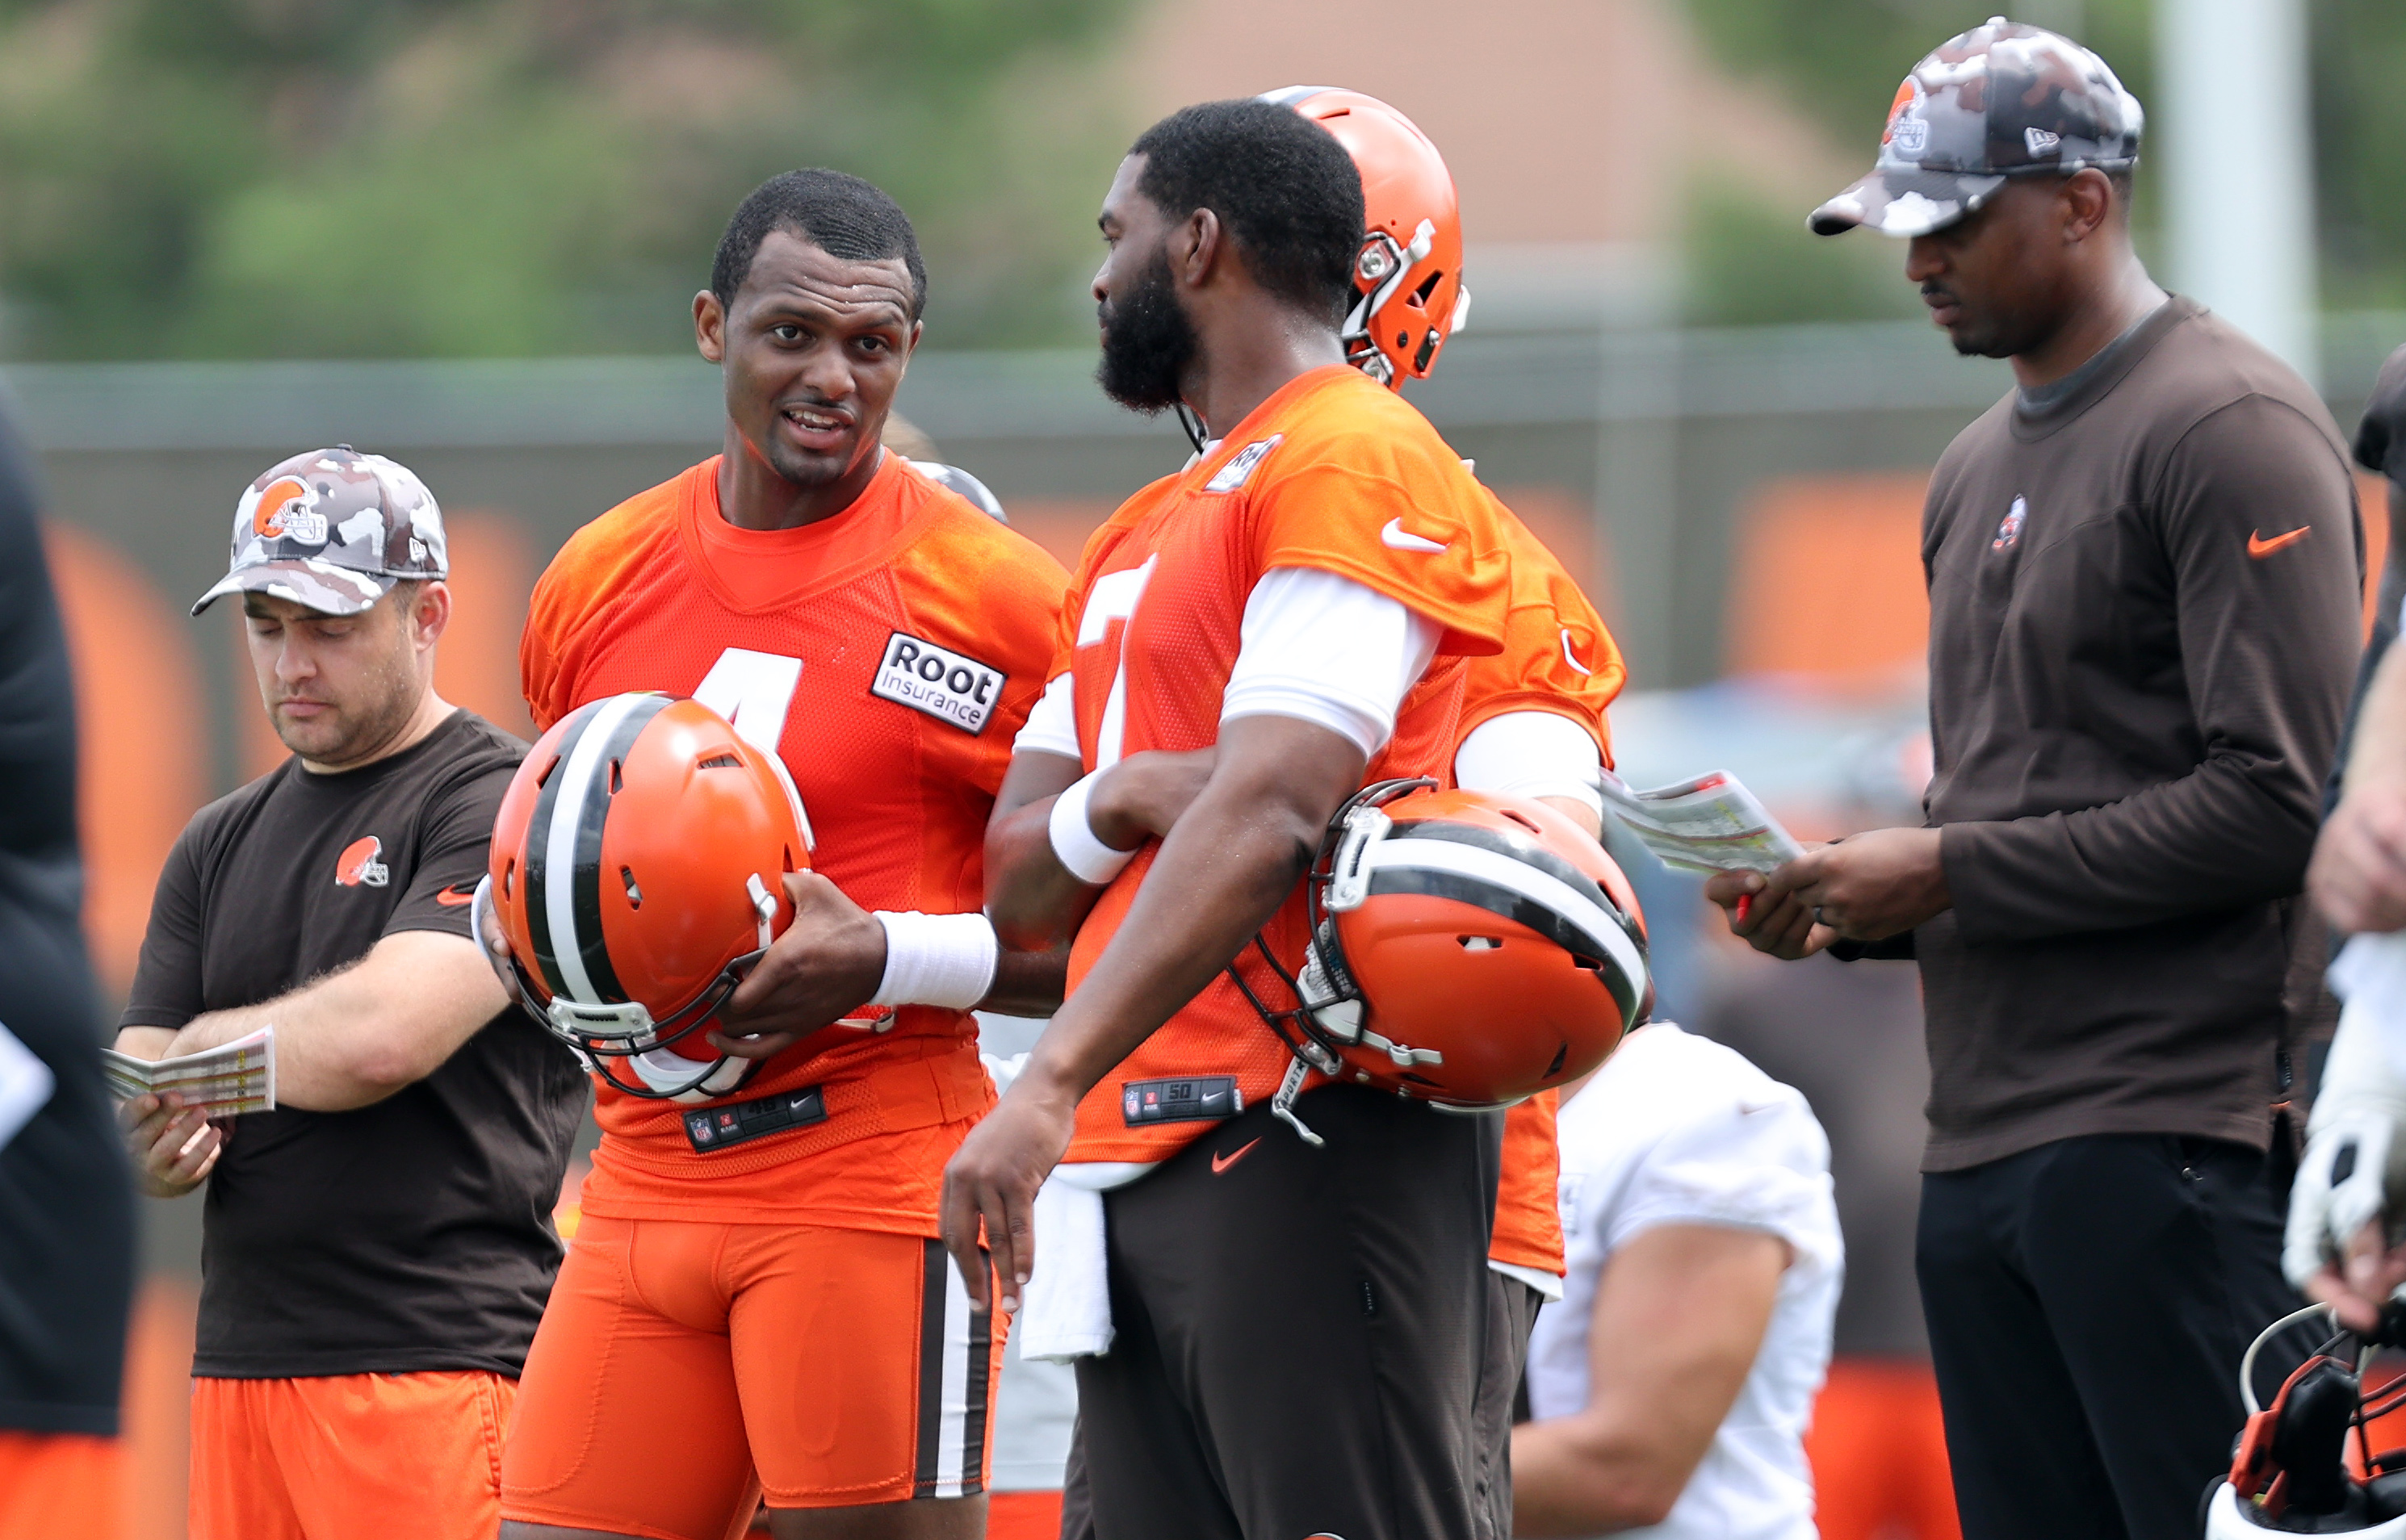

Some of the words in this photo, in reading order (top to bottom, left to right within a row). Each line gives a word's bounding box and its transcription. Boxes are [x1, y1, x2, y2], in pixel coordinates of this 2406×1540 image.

[890, 638, 992, 705] Root
[1077, 552, 1157, 771] 7
[691, 647, 803, 752] 4
[882, 670, 981, 724] Insurance
[1168, 1083, 1192, 1099] 50
